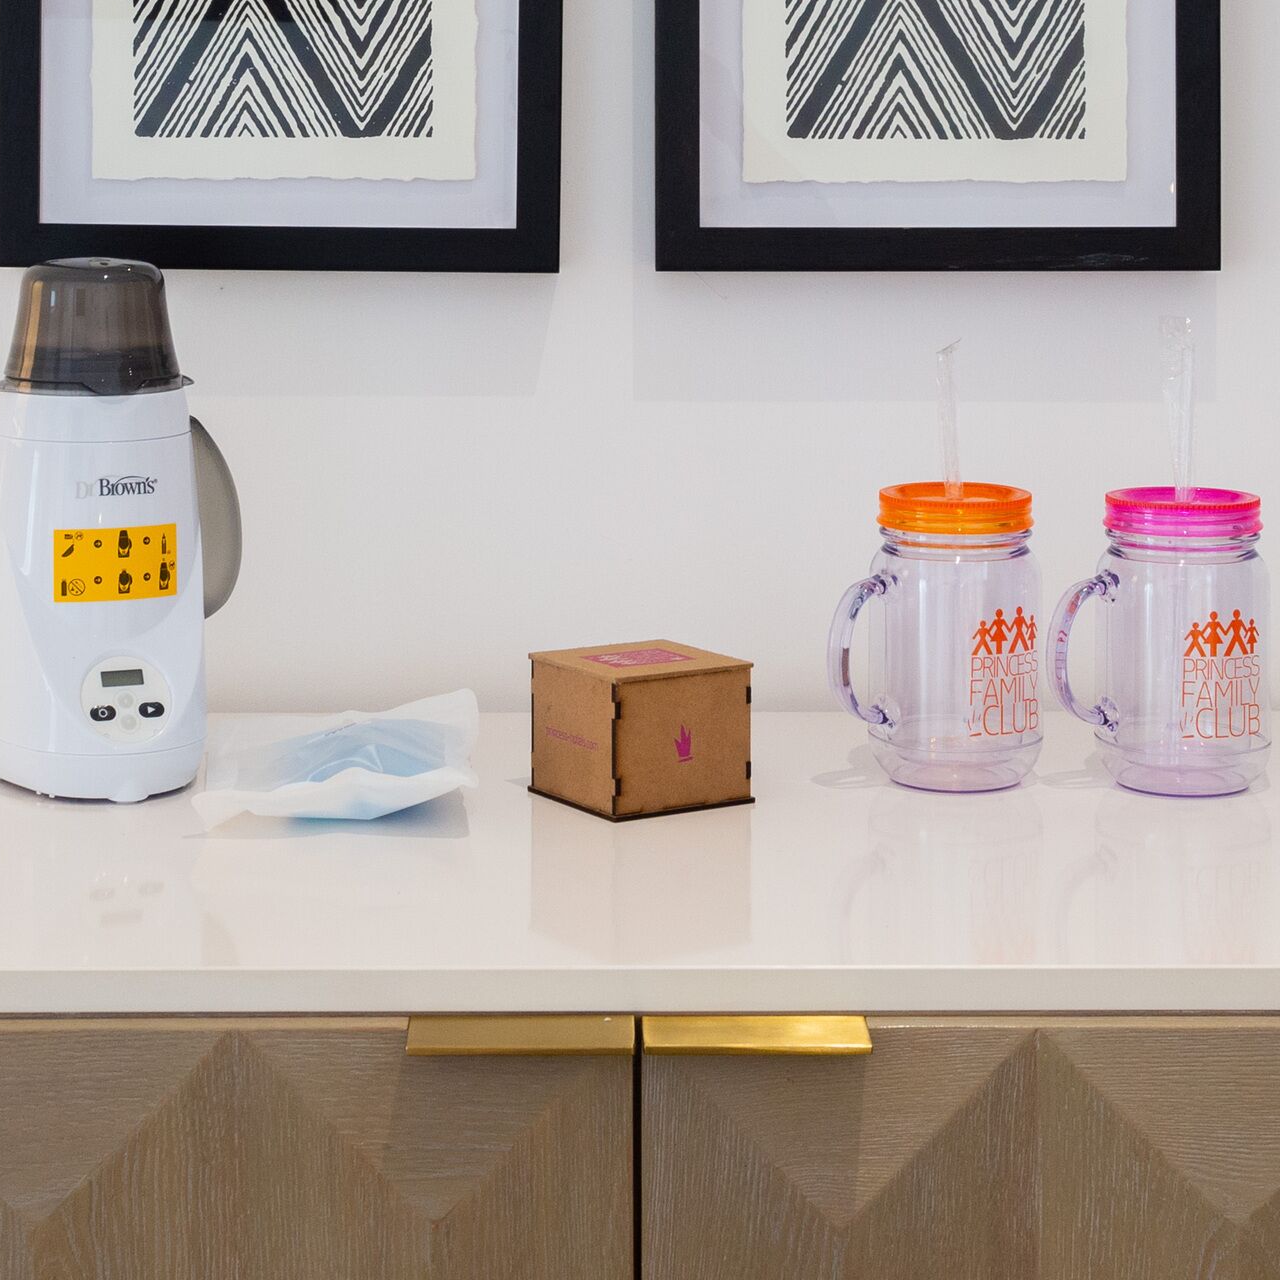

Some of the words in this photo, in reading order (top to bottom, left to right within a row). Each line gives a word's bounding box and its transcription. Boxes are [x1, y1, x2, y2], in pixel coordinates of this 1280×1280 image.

[970, 650, 1039, 678] PRINCESS
[1182, 655, 1261, 681] PRINCESS
[970, 672, 1039, 706] FAMILY
[1182, 677, 1261, 708] FAMILY
[982, 698, 1039, 736] CLUB
[1195, 703, 1261, 739] CLUB
